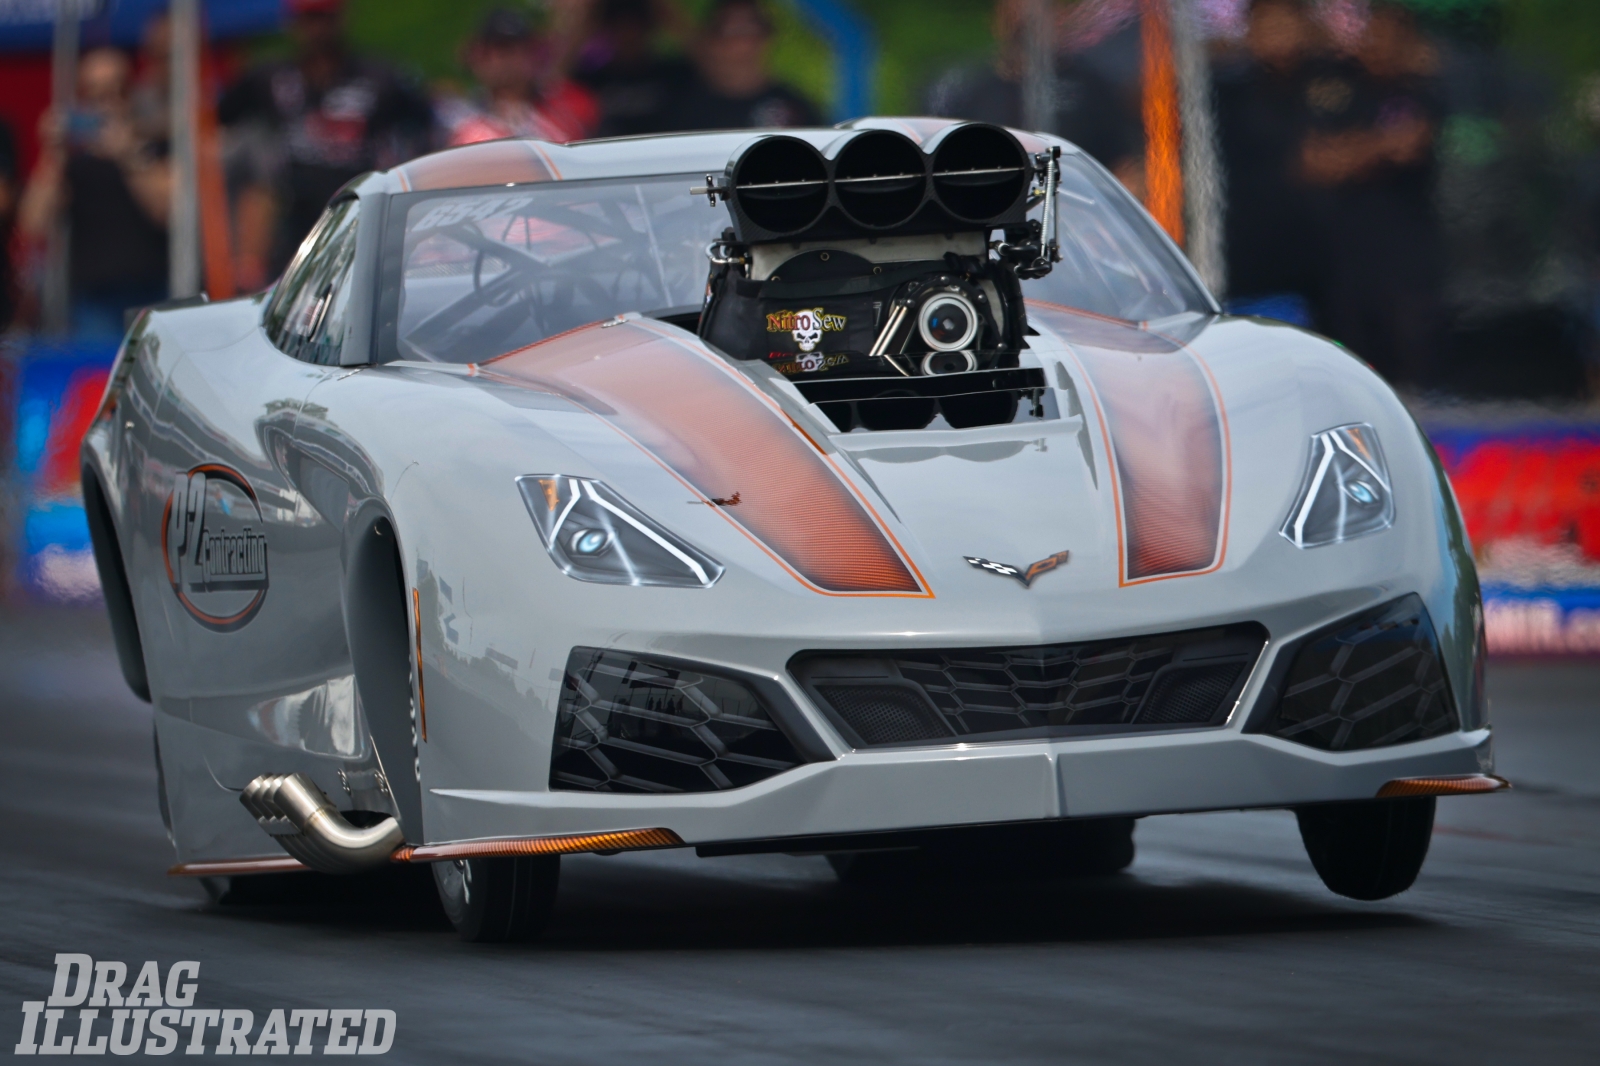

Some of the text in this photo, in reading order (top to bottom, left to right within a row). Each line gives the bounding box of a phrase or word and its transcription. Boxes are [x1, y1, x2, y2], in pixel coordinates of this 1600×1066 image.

[766, 307, 847, 332] Nitro Sew
[171, 472, 269, 590] P2 Contracting
